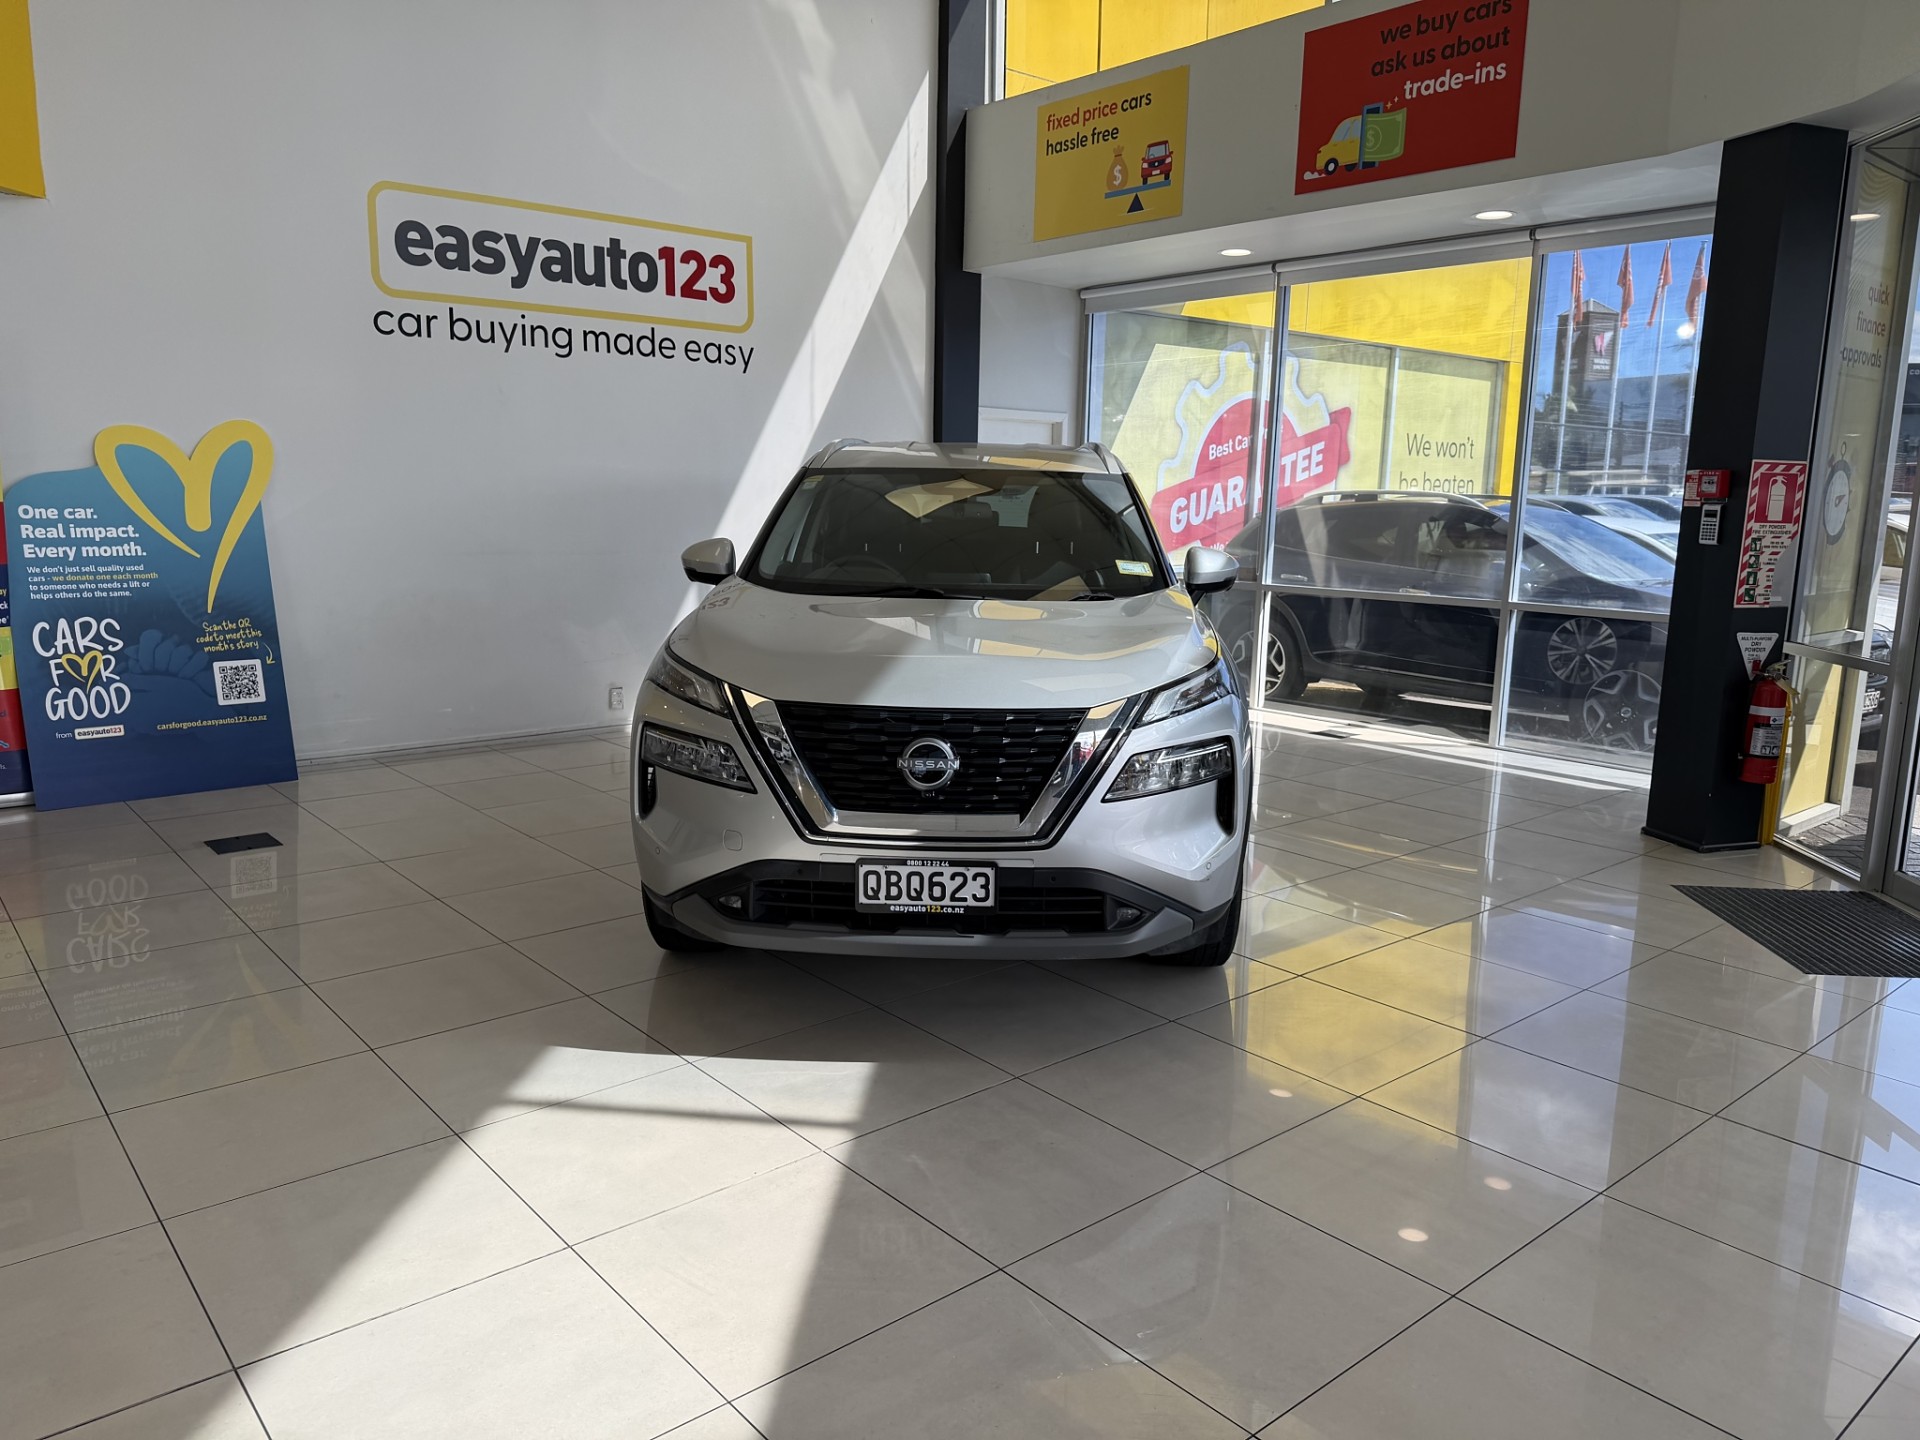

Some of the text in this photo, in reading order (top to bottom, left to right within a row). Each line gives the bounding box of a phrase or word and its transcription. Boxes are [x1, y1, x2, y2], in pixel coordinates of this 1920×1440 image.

[1380, 0, 1512, 44] we buy cars
[1371, 26, 1510, 76] ask us about
[1404, 62, 1506, 99] trade-ins
[1046, 93, 1152, 131] fixed price cars
[1046, 127, 1119, 156] hassle free
[394, 220, 736, 304] easyauto123
[1868, 282, 1890, 306] quick
[1856, 310, 1886, 337] finance
[373, 307, 754, 374] car buying made easy
[1842, 346, 1882, 368] approvals
[1209, 439, 1233, 460] Best
[1406, 433, 1474, 459] We won't
[1170, 441, 1325, 533] GUARTEE
[1423, 471, 1474, 494] beaten
[18, 504, 98, 519] One car.
[20, 523, 140, 541] Real impact.
[23, 542, 147, 561] Every month.
[65, 566, 80, 574] just
[98, 564, 124, 572] quality
[30, 592, 53, 600] helps
[55, 590, 80, 598] others
[32, 616, 124, 657] CARS
[196, 633, 213, 643] code
[226, 629, 245, 640] meet
[245, 628, 262, 638] this
[202, 618, 252, 632] Scan the QR
[204, 639, 259, 653] month's story
[45, 682, 131, 721] GOOD
[55, 726, 122, 739] from easyauto123
[157, 714, 268, 731] carsforgood.easyauto123.co.nz
[898, 759, 957, 769] NISSAN
[863, 870, 990, 902] QBQ623
[890, 904, 964, 914] easyauto123.co.nz
